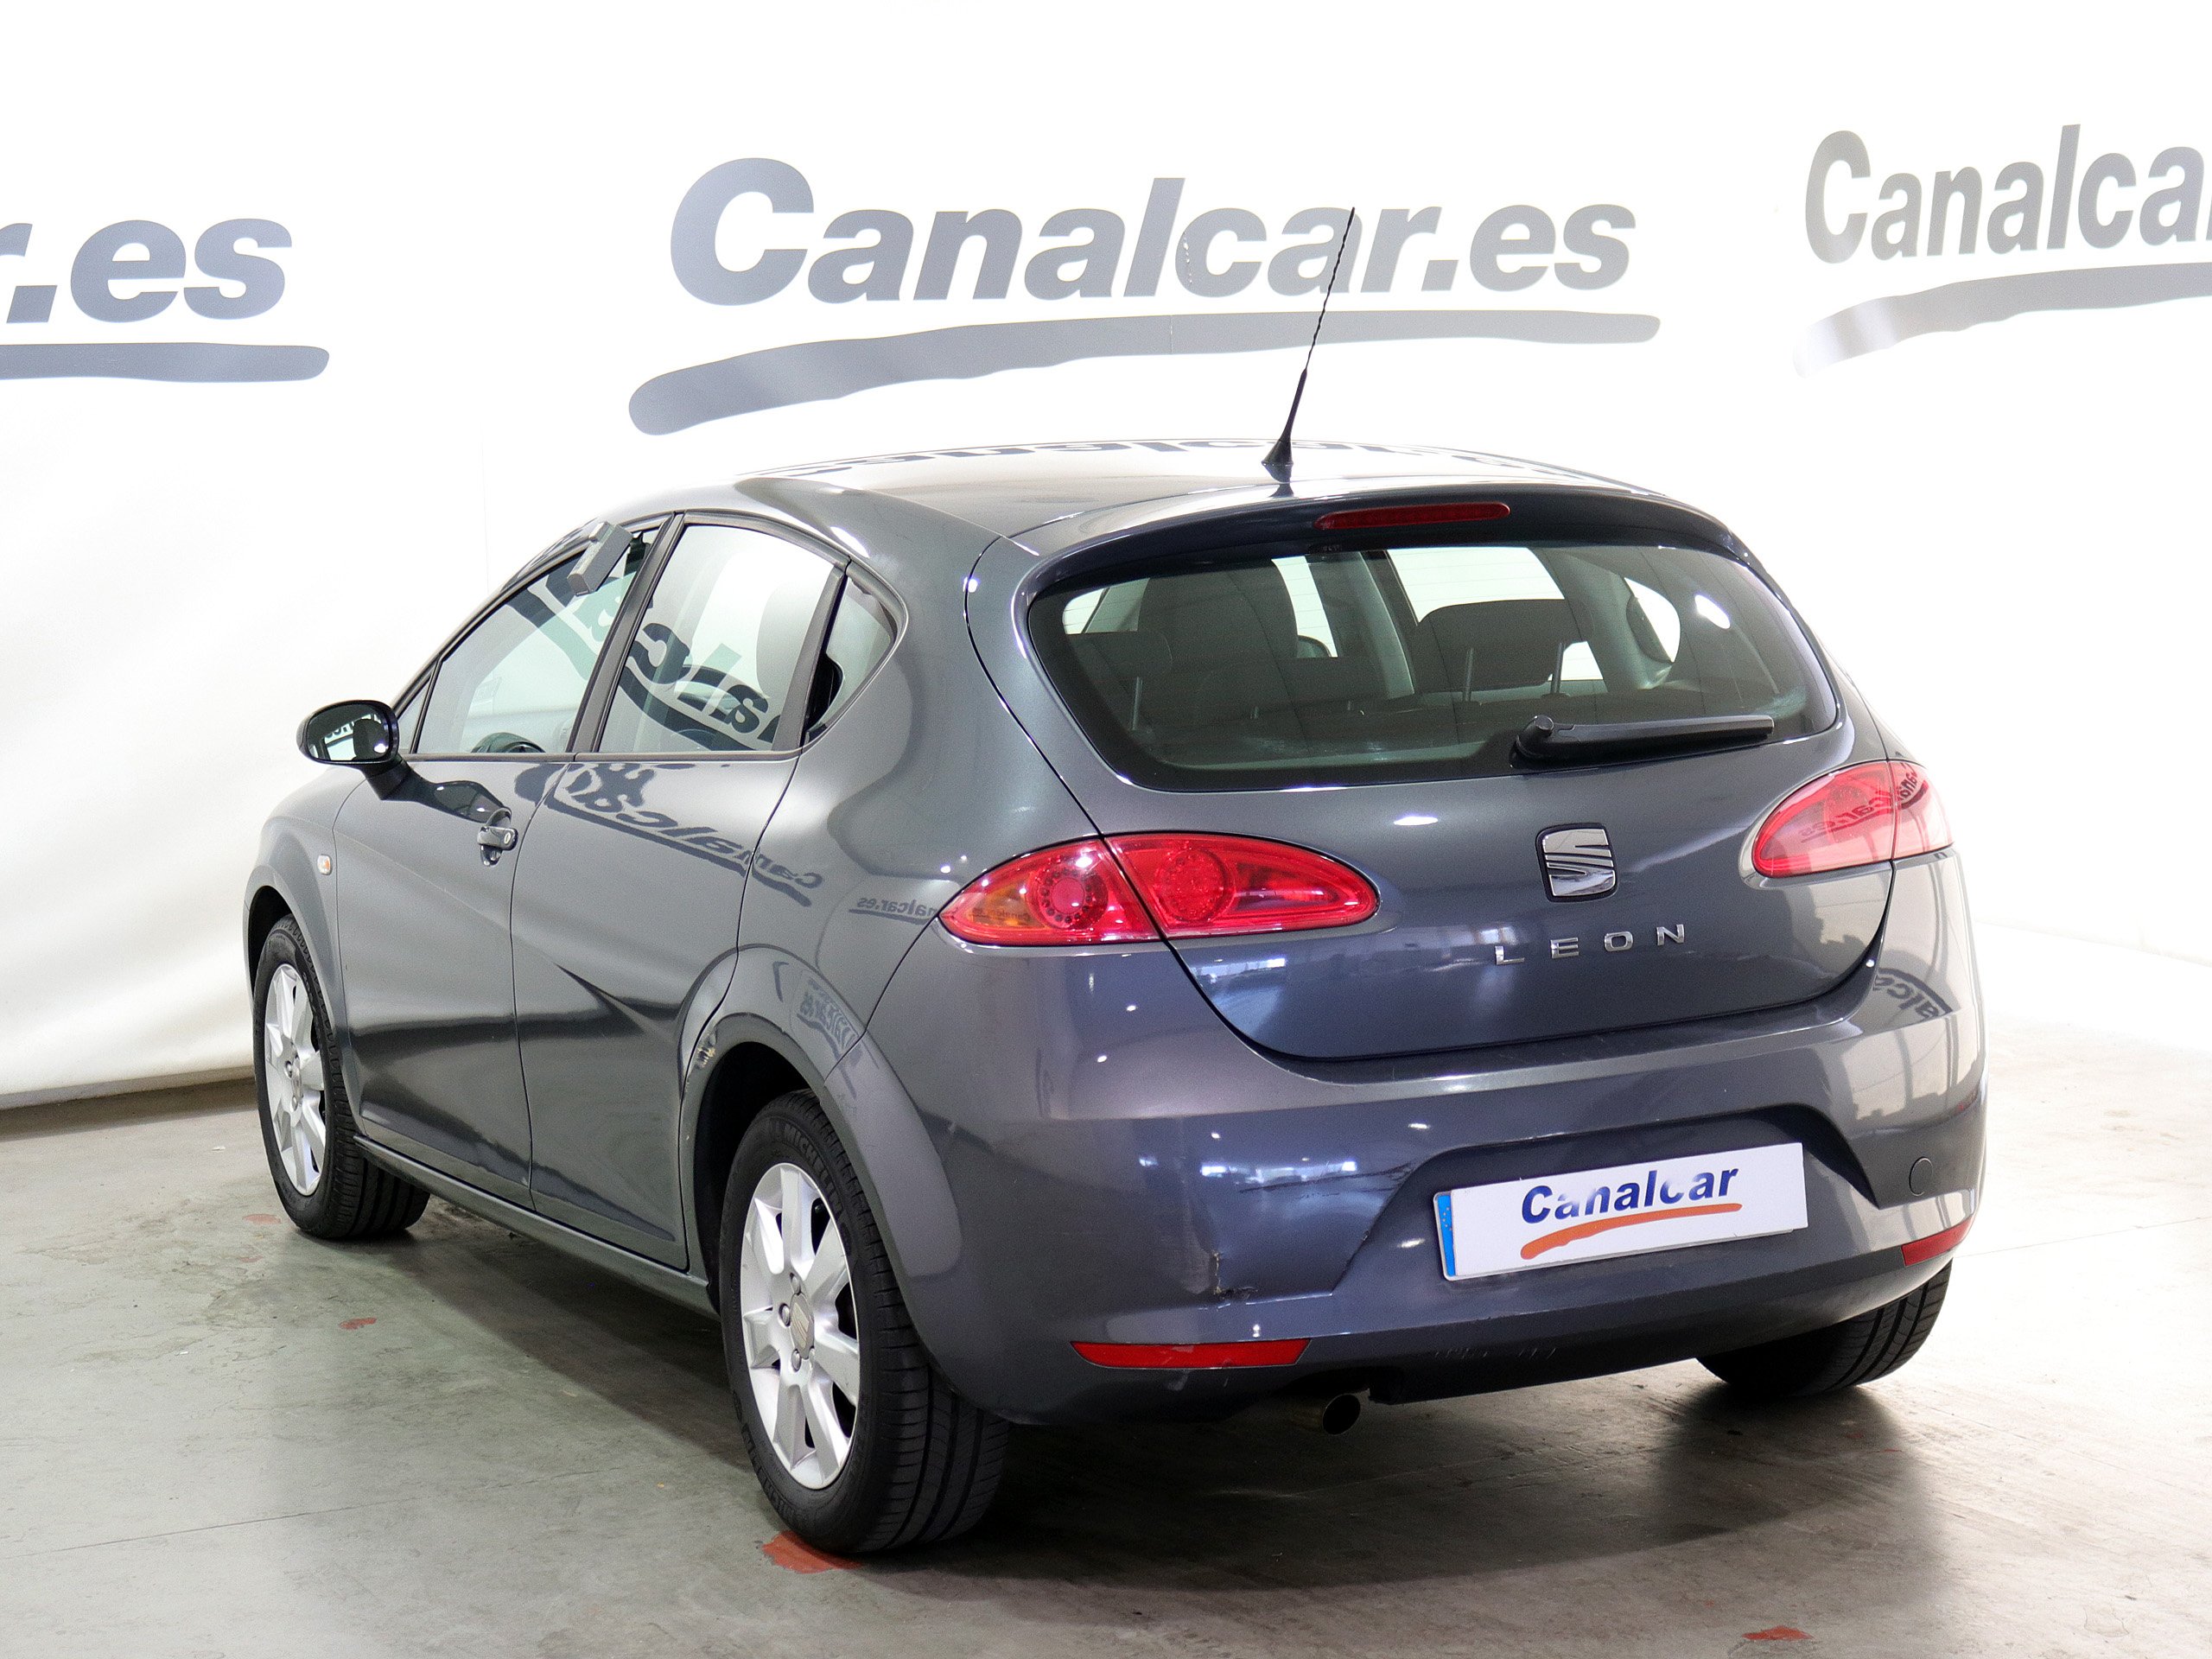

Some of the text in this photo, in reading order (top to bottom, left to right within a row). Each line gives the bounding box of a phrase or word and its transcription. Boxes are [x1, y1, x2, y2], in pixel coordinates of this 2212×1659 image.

[671, 157, 1637, 306] Canalcar.es
[1806, 124, 2212, 264] Canalca
[1495, 924, 1685, 966] LEON
[1521, 1166, 1739, 1224] Canalcar
